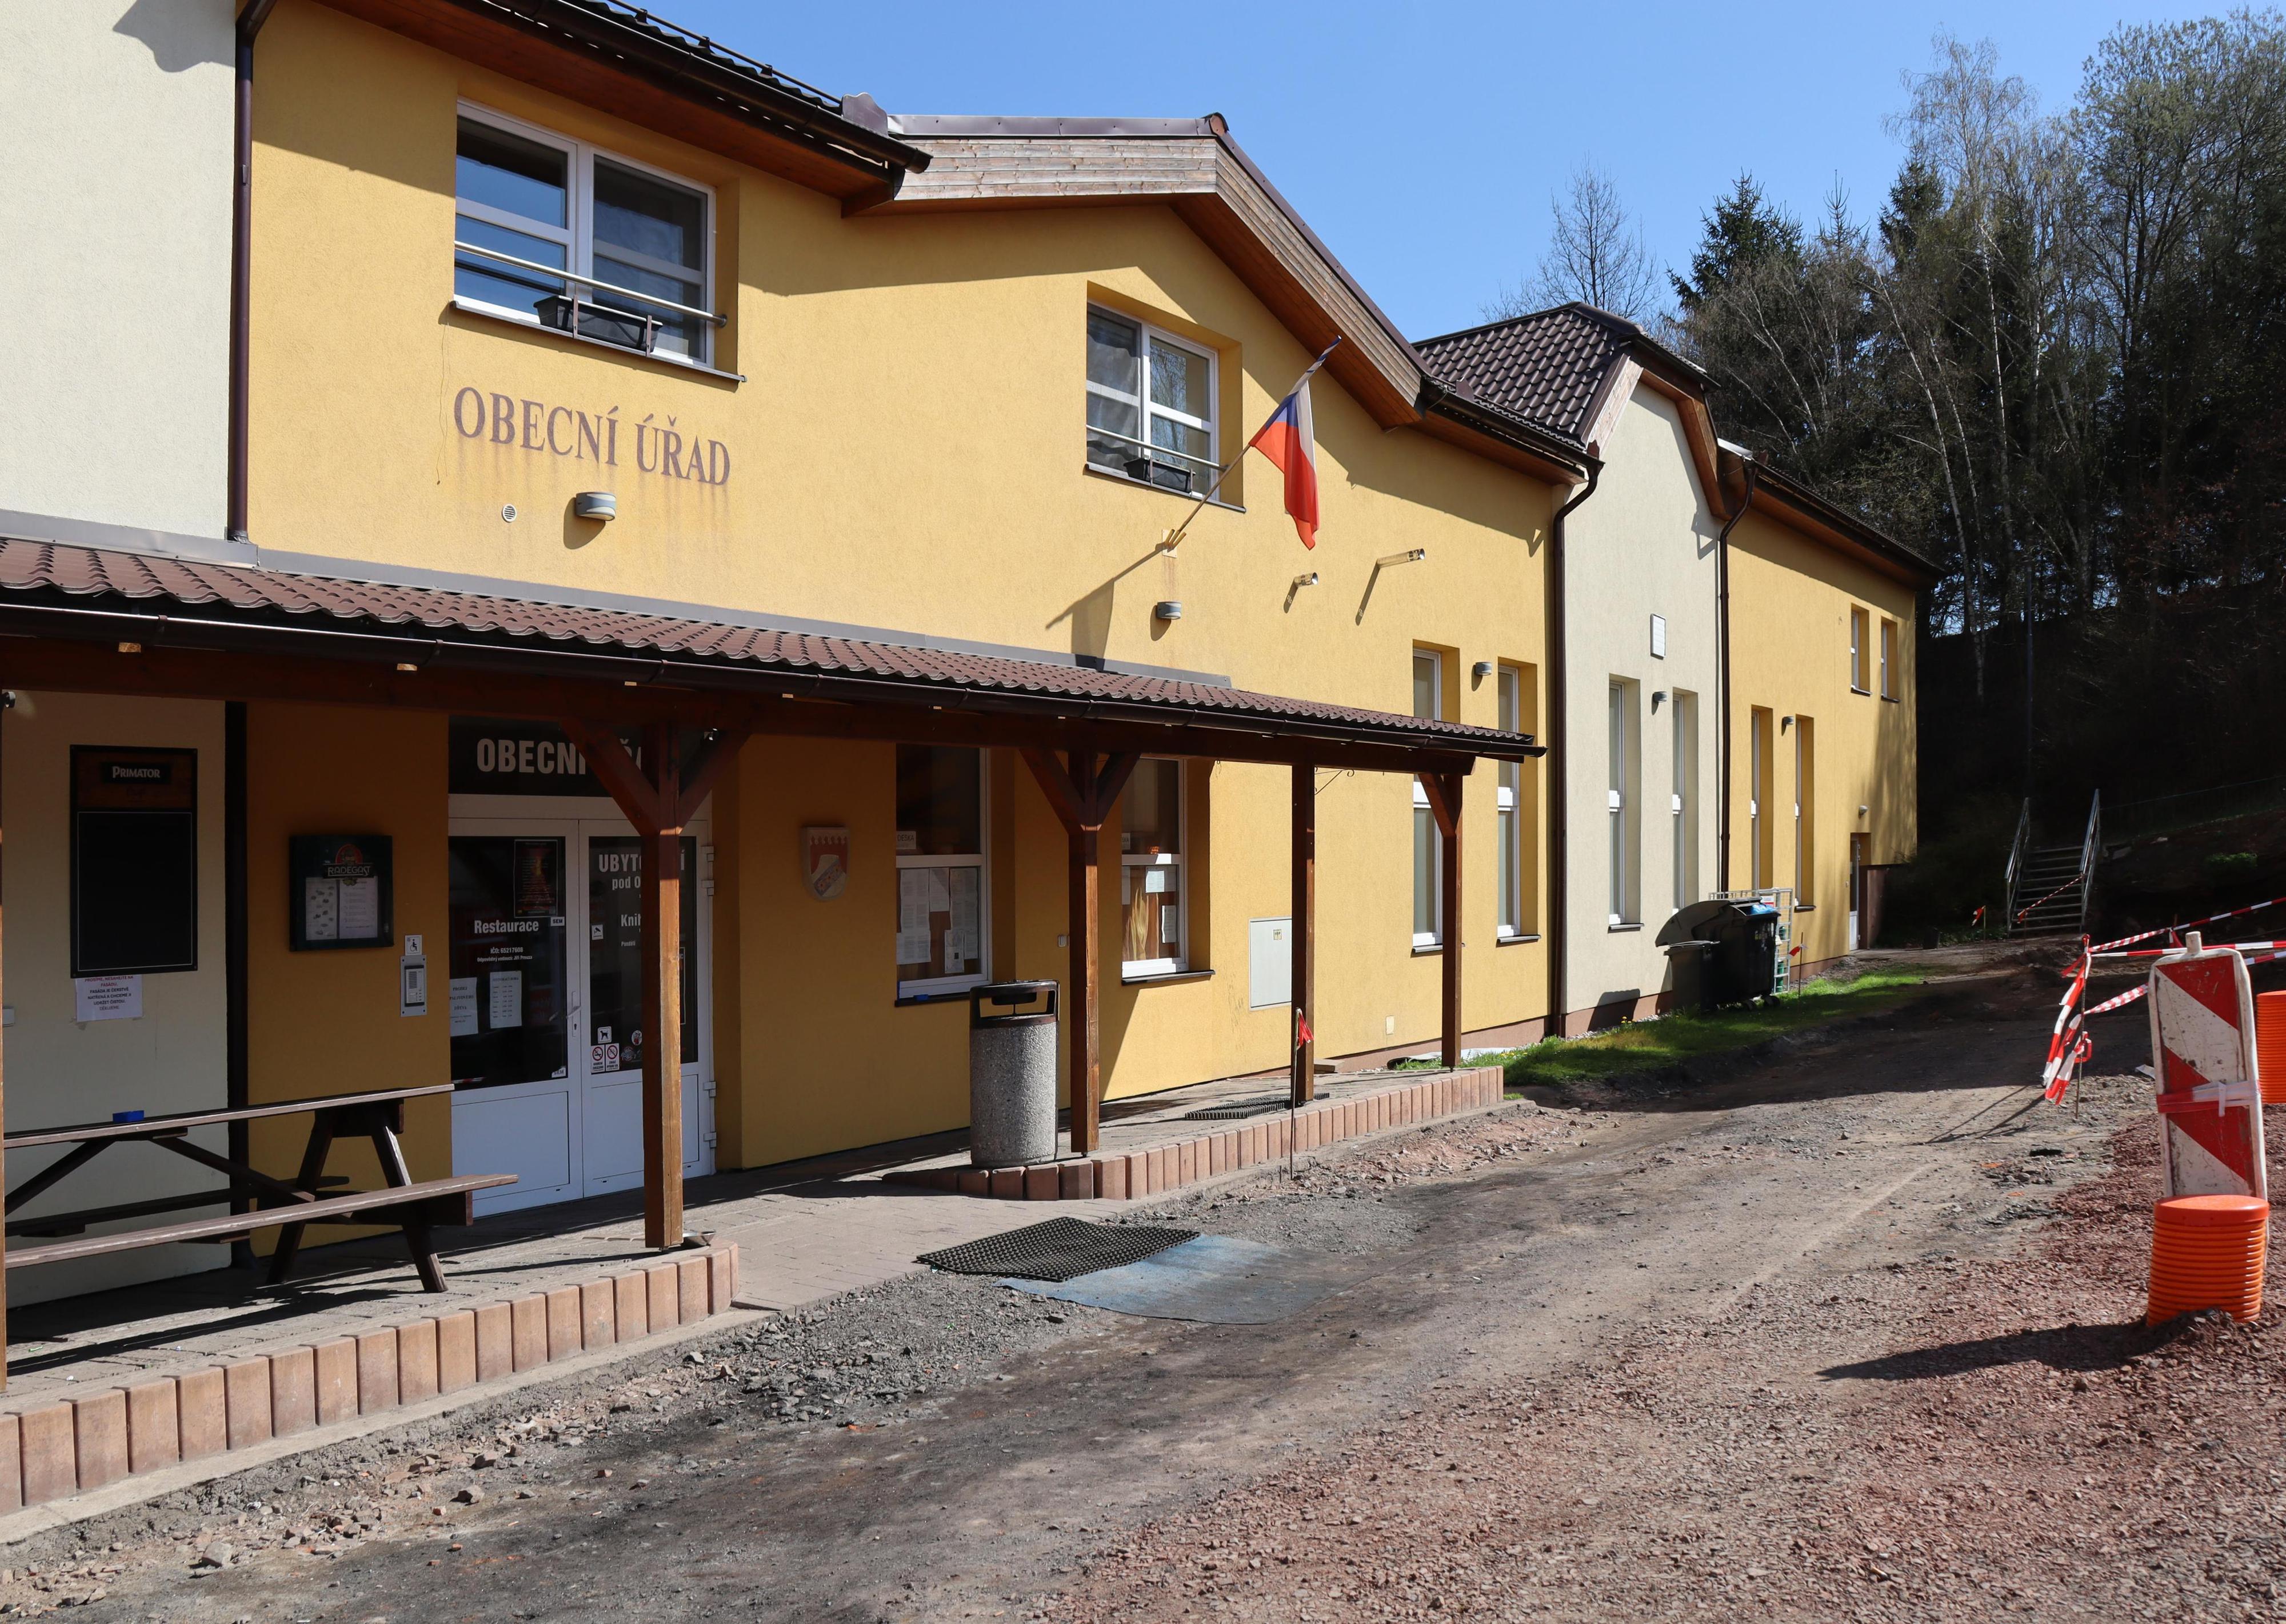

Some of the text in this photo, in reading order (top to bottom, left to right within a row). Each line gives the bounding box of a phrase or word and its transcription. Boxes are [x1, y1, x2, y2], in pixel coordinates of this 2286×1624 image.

[454, 387, 730, 485] OBECNÍ ÚŘAD
[112, 766, 161, 778] PRIMATOR
[327, 866, 371, 876] RADEGAST
[612, 876, 631, 890] pod
[474, 919, 539, 934] Restaurace
